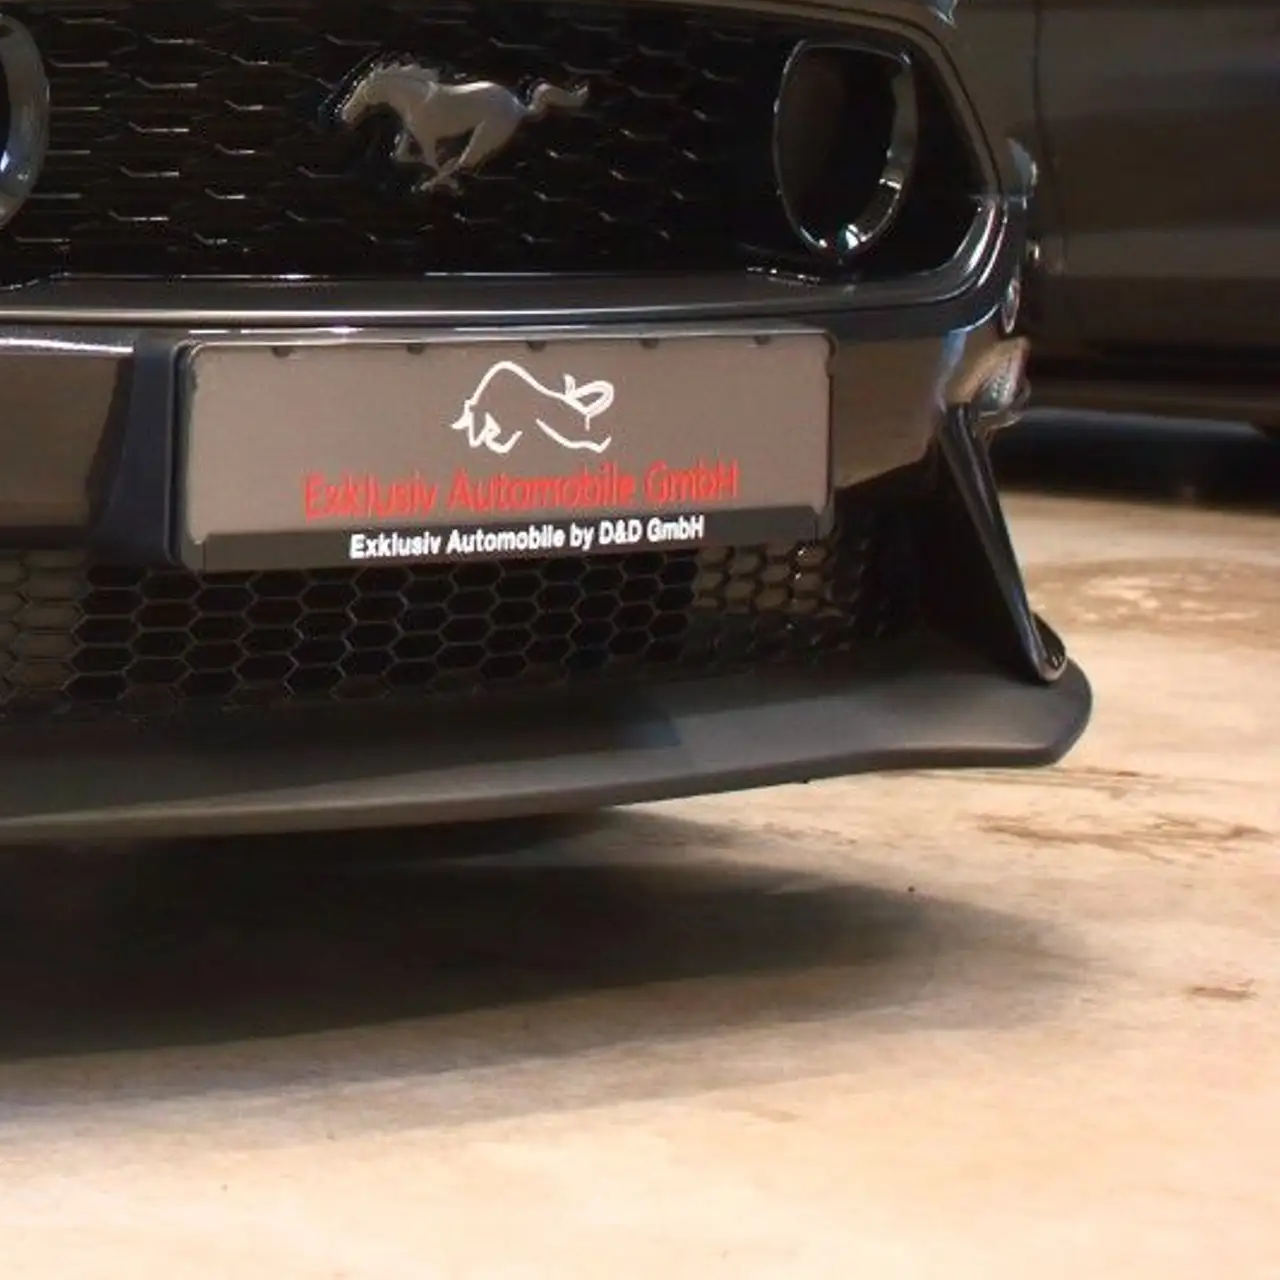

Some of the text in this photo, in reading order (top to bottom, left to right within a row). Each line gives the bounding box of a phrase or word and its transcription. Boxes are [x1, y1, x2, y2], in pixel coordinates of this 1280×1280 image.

[304, 458, 738, 523] Exklusiv Automobile GmbH
[348, 515, 705, 559] Exklusiv Automobile by D&D GmbH
